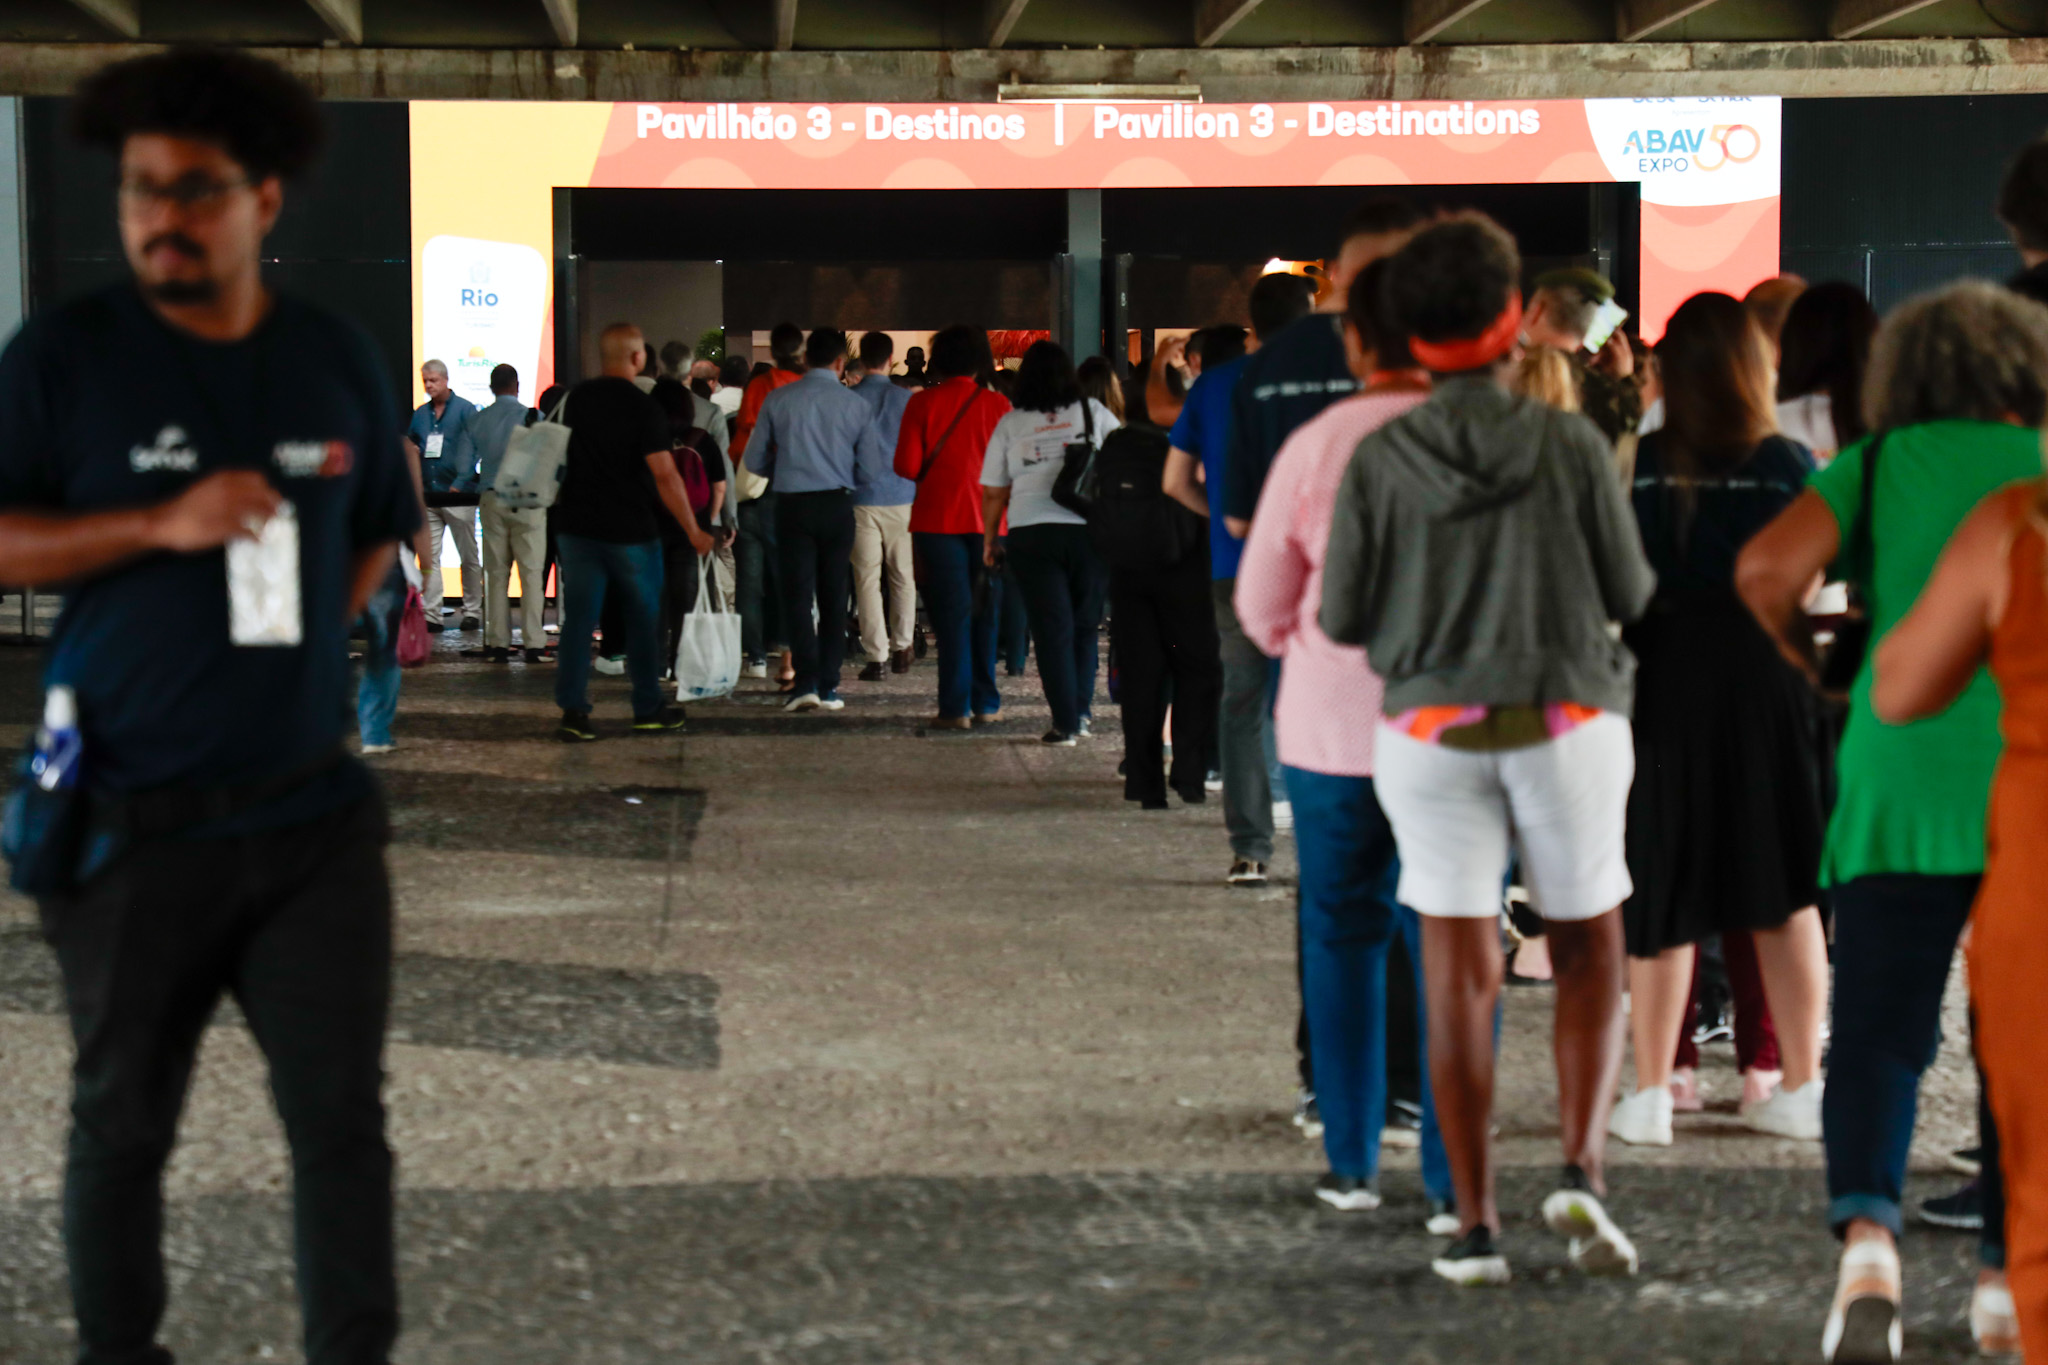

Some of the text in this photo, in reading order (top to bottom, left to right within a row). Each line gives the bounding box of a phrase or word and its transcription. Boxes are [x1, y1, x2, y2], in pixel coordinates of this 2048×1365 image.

[636, 103, 798, 140] Pavilhão
[807, 106, 832, 140] 3
[866, 105, 1026, 141] Destinos
[1094, 103, 1240, 140] Pavilion
[1250, 104, 1275, 138] 3
[1308, 102, 1542, 137] Destinations
[1623, 124, 1762, 172] ABAV 50
[1638, 157, 1690, 173] EXPO
[461, 288, 499, 307] Rio
